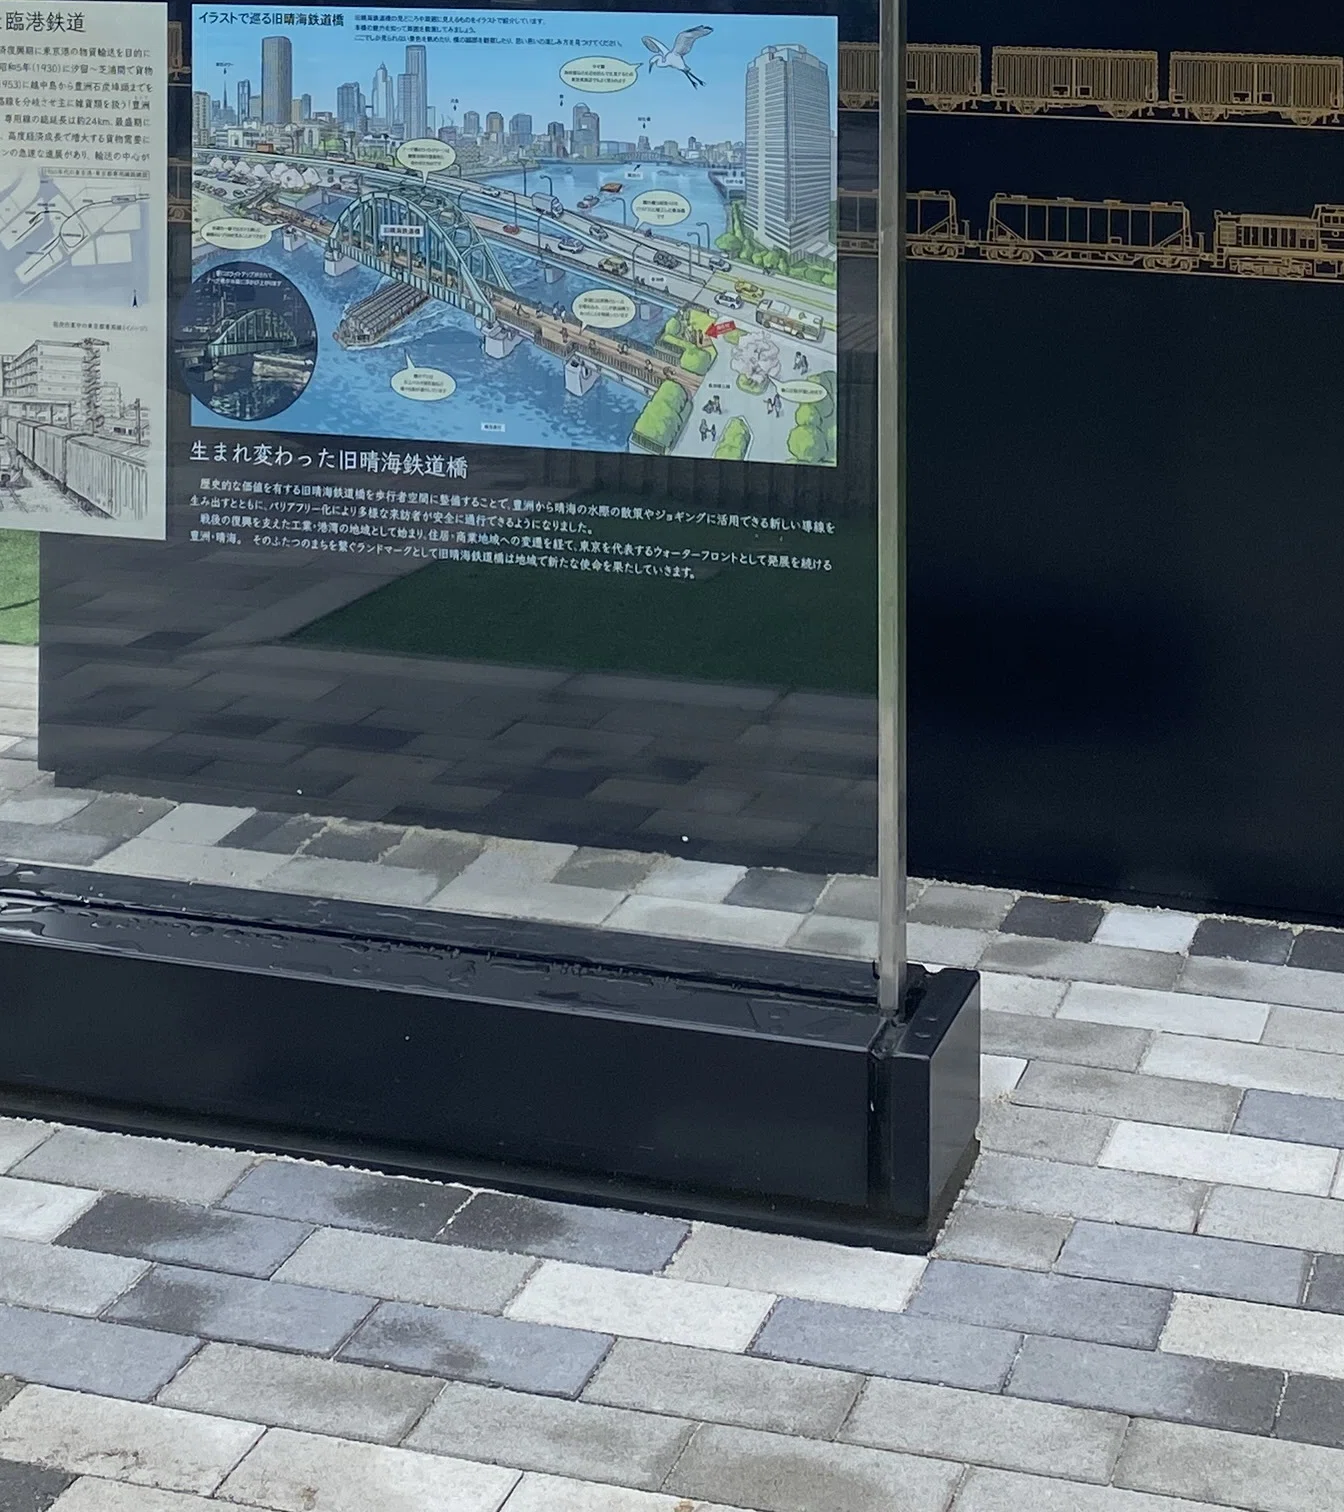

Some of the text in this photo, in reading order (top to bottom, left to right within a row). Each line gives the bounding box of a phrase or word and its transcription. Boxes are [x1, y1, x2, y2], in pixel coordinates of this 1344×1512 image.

[198, 11, 345, 27] イラストで巡る旧晴海鉄道橋
[189, 441, 469, 479] 生まれ変わった旧晴海鉄道橋
